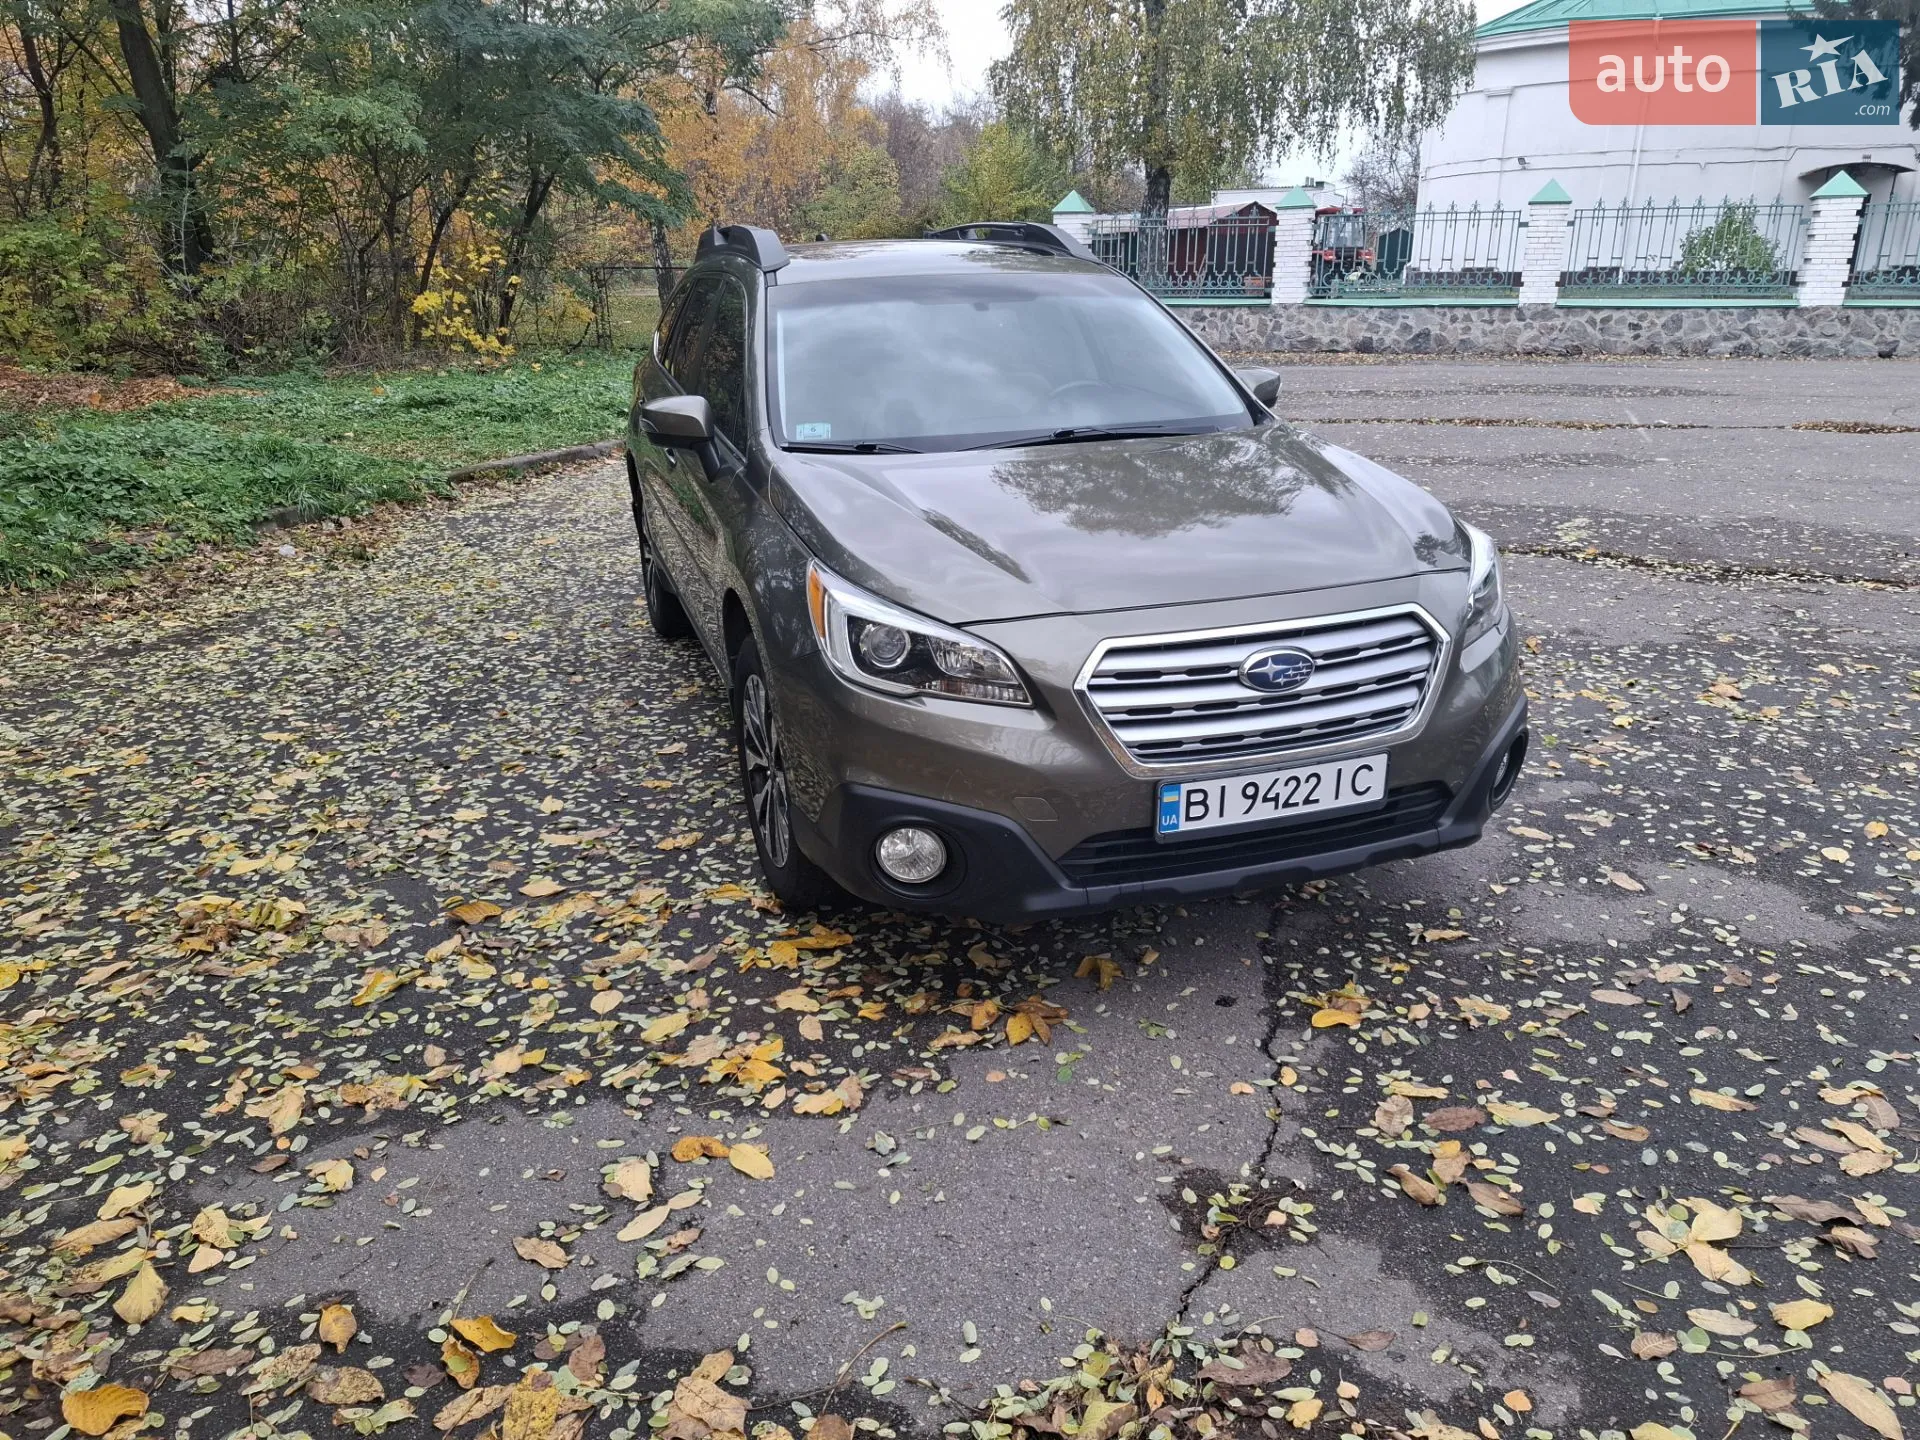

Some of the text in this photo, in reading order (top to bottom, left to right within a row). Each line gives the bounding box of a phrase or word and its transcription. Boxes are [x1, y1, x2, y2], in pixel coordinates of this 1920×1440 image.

[1184, 763, 1374, 822] BI 9422 IC
[1162, 814, 1178, 826] UA
